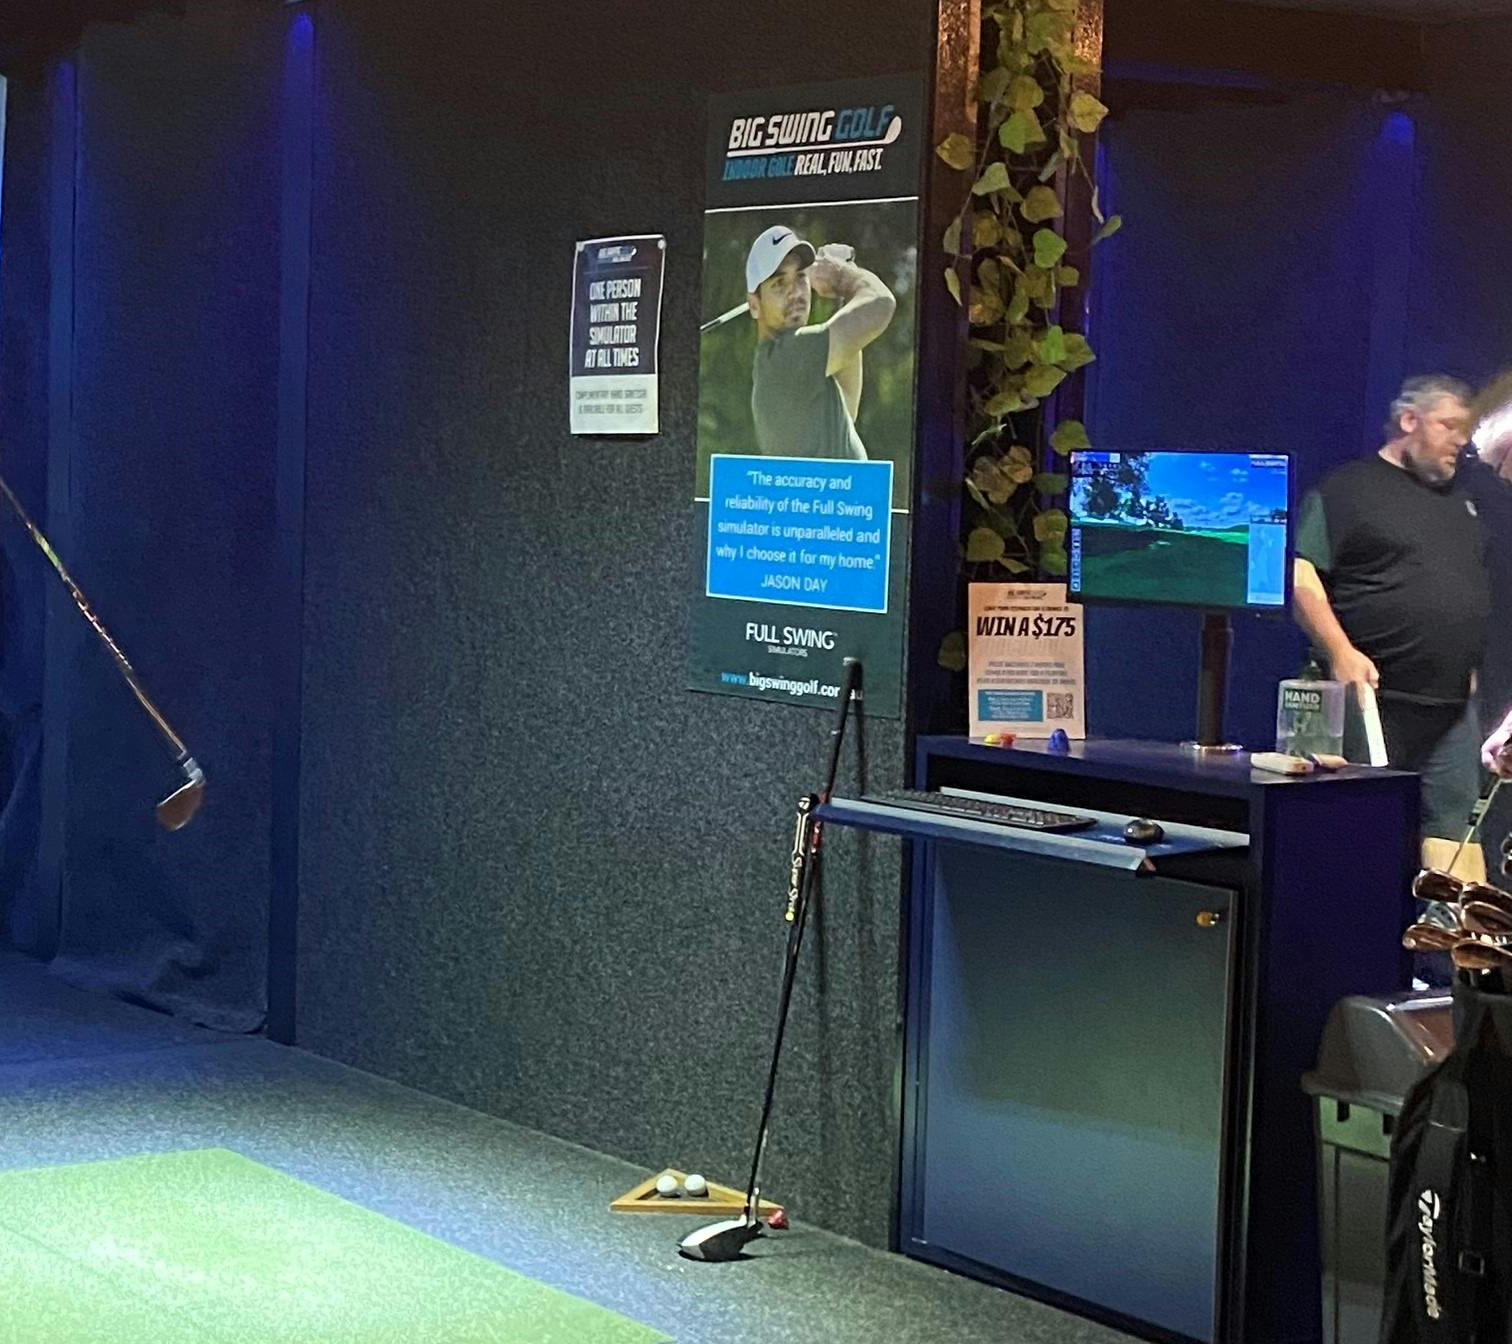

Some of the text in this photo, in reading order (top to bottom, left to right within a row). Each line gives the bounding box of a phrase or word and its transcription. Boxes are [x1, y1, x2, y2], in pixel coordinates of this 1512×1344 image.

[728, 104, 894, 149] BIG SWING GOLF
[794, 153, 827, 177] REAL,
[828, 150, 853, 174] FUN,
[589, 278, 641, 300] ONE PERSON
[590, 301, 638, 323] WITHIN THE
[589, 325, 637, 345] SIMULATOR
[584, 347, 640, 368] AT ALL TIMES
[774, 475, 827, 492] accuracy
[828, 476, 852, 490] and
[725, 495, 873, 520] reliability of the Full Swing
[718, 520, 880, 544] simulator is unparalleled and
[716, 544, 737, 560] why
[746, 546, 786, 563] choose
[789, 550, 797, 563] it
[800, 549, 816, 564] for
[819, 554, 836, 570] my
[760, 574, 828, 593] JASON DAY
[745, 622, 835, 650] FULL SWING
[976, 613, 1076, 639] WIN A $175
[1284, 690, 1320, 704] HAND
